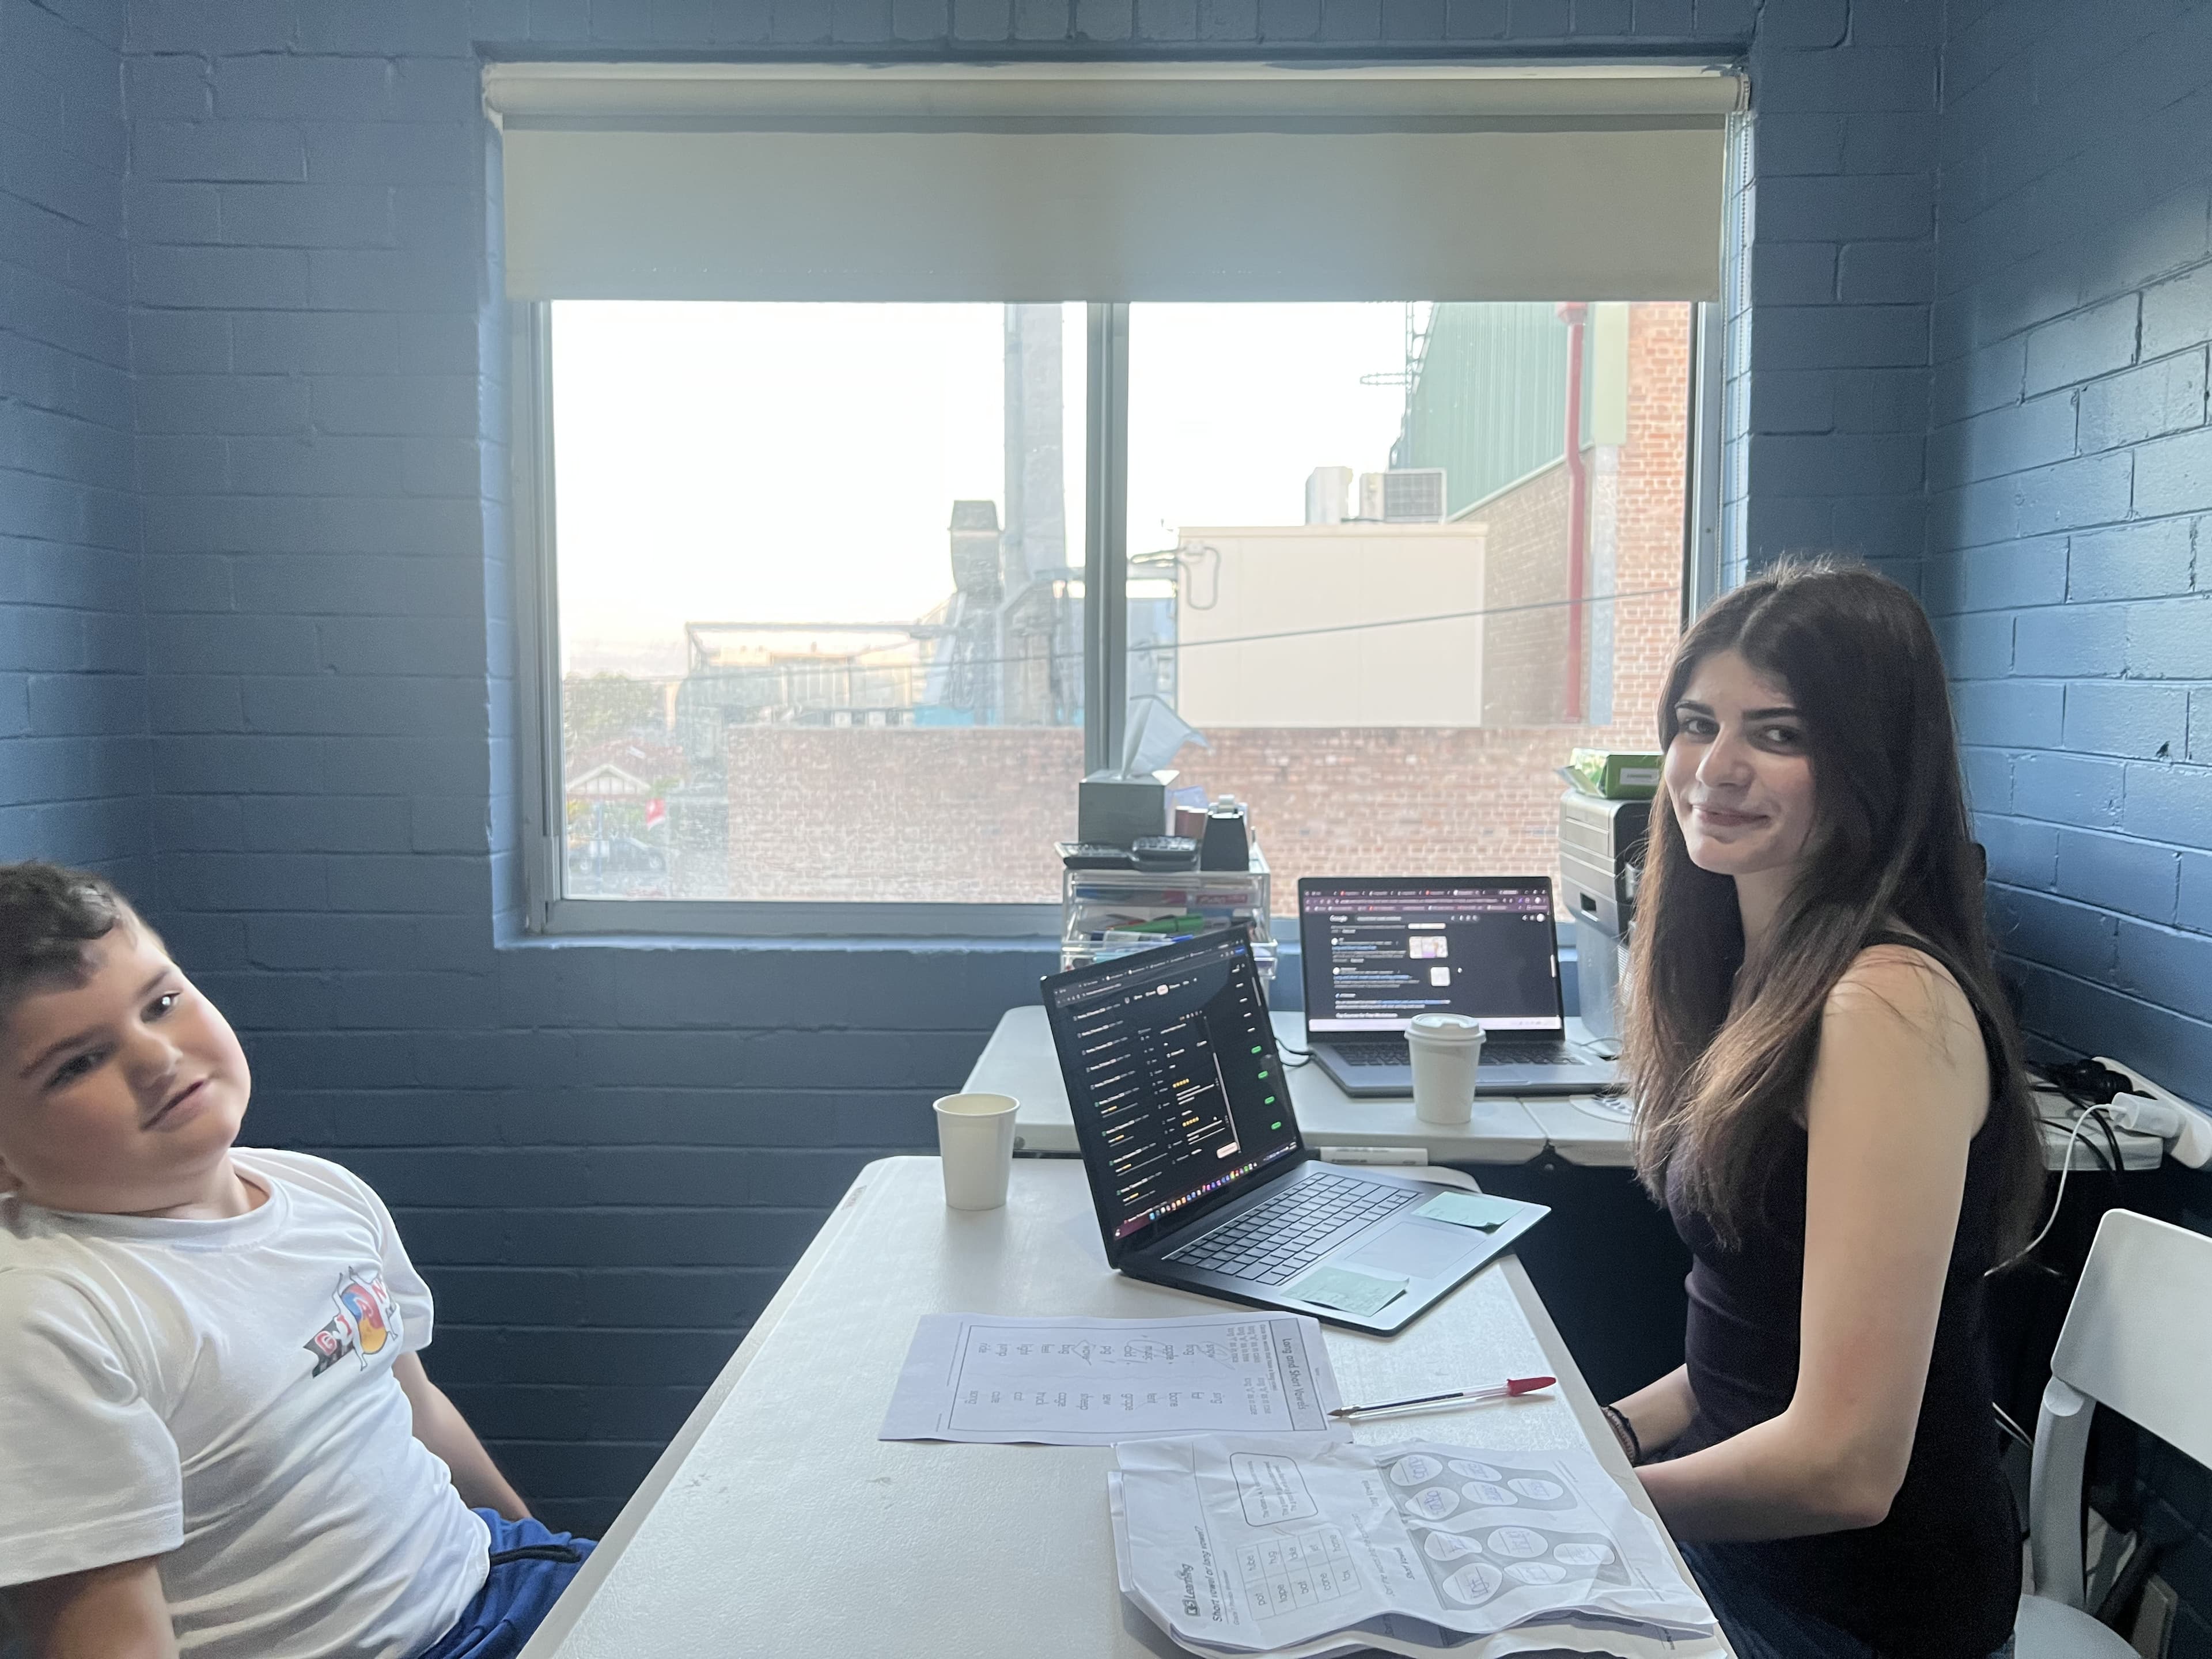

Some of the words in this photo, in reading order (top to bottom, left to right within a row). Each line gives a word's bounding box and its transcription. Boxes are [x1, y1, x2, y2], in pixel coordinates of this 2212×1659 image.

[1100, 1346, 1115, 1354] pig
[1282, 1338, 1293, 1354] Long
[1287, 1355, 1299, 1369] and
[1289, 1370, 1301, 1387] Short
[1121, 1393, 1133, 1410] grape
[1294, 1388, 1309, 1410] Vowels
[1202, 1551, 1211, 1566] long
[1267, 1550, 1277, 1565] hug
[1181, 1564, 1195, 1599] Learning
[1205, 1576, 1218, 1598] vowel
[1320, 1573, 1331, 1590] cone
[1255, 1592, 1267, 1606] pot
[1277, 1584, 1288, 1603] tape
[1210, 1599, 1222, 1622] Short
